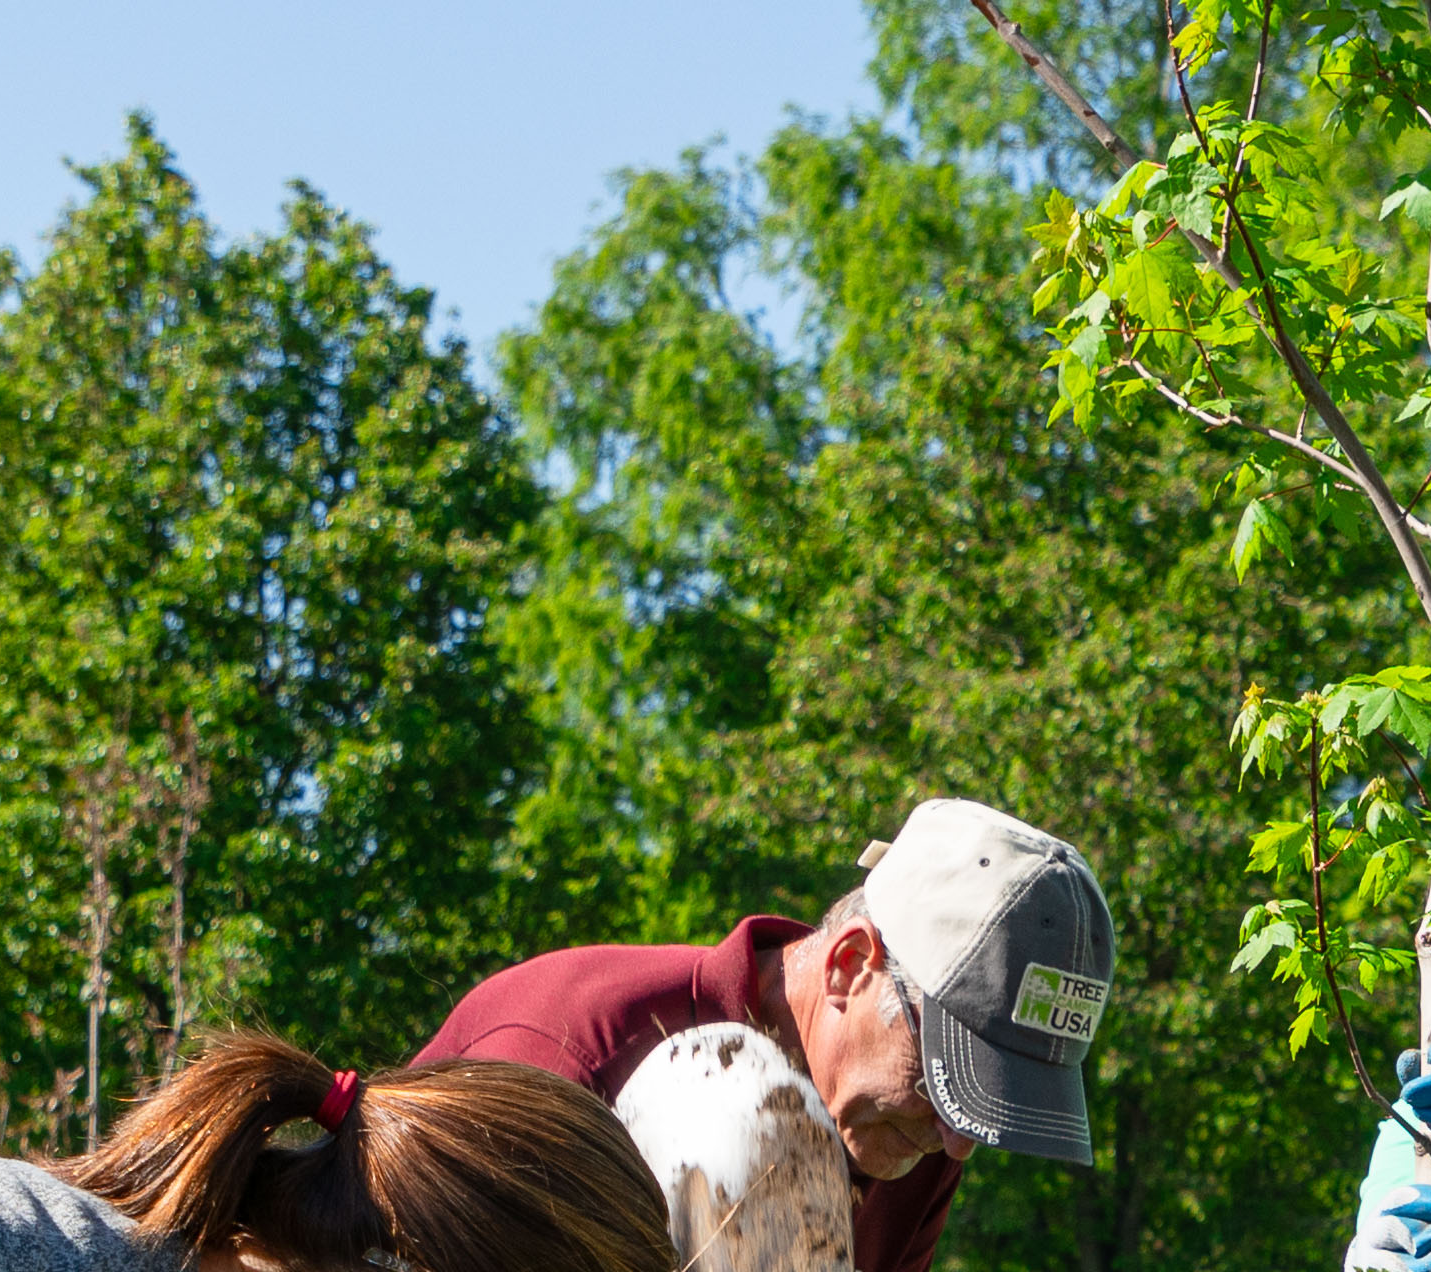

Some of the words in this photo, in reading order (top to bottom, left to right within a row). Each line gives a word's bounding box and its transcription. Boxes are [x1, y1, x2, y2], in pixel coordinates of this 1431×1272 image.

[1062, 976, 1105, 1003] TREE
[1050, 1007, 1092, 1037] USA
[931, 1058, 1001, 1145] arborday.org
